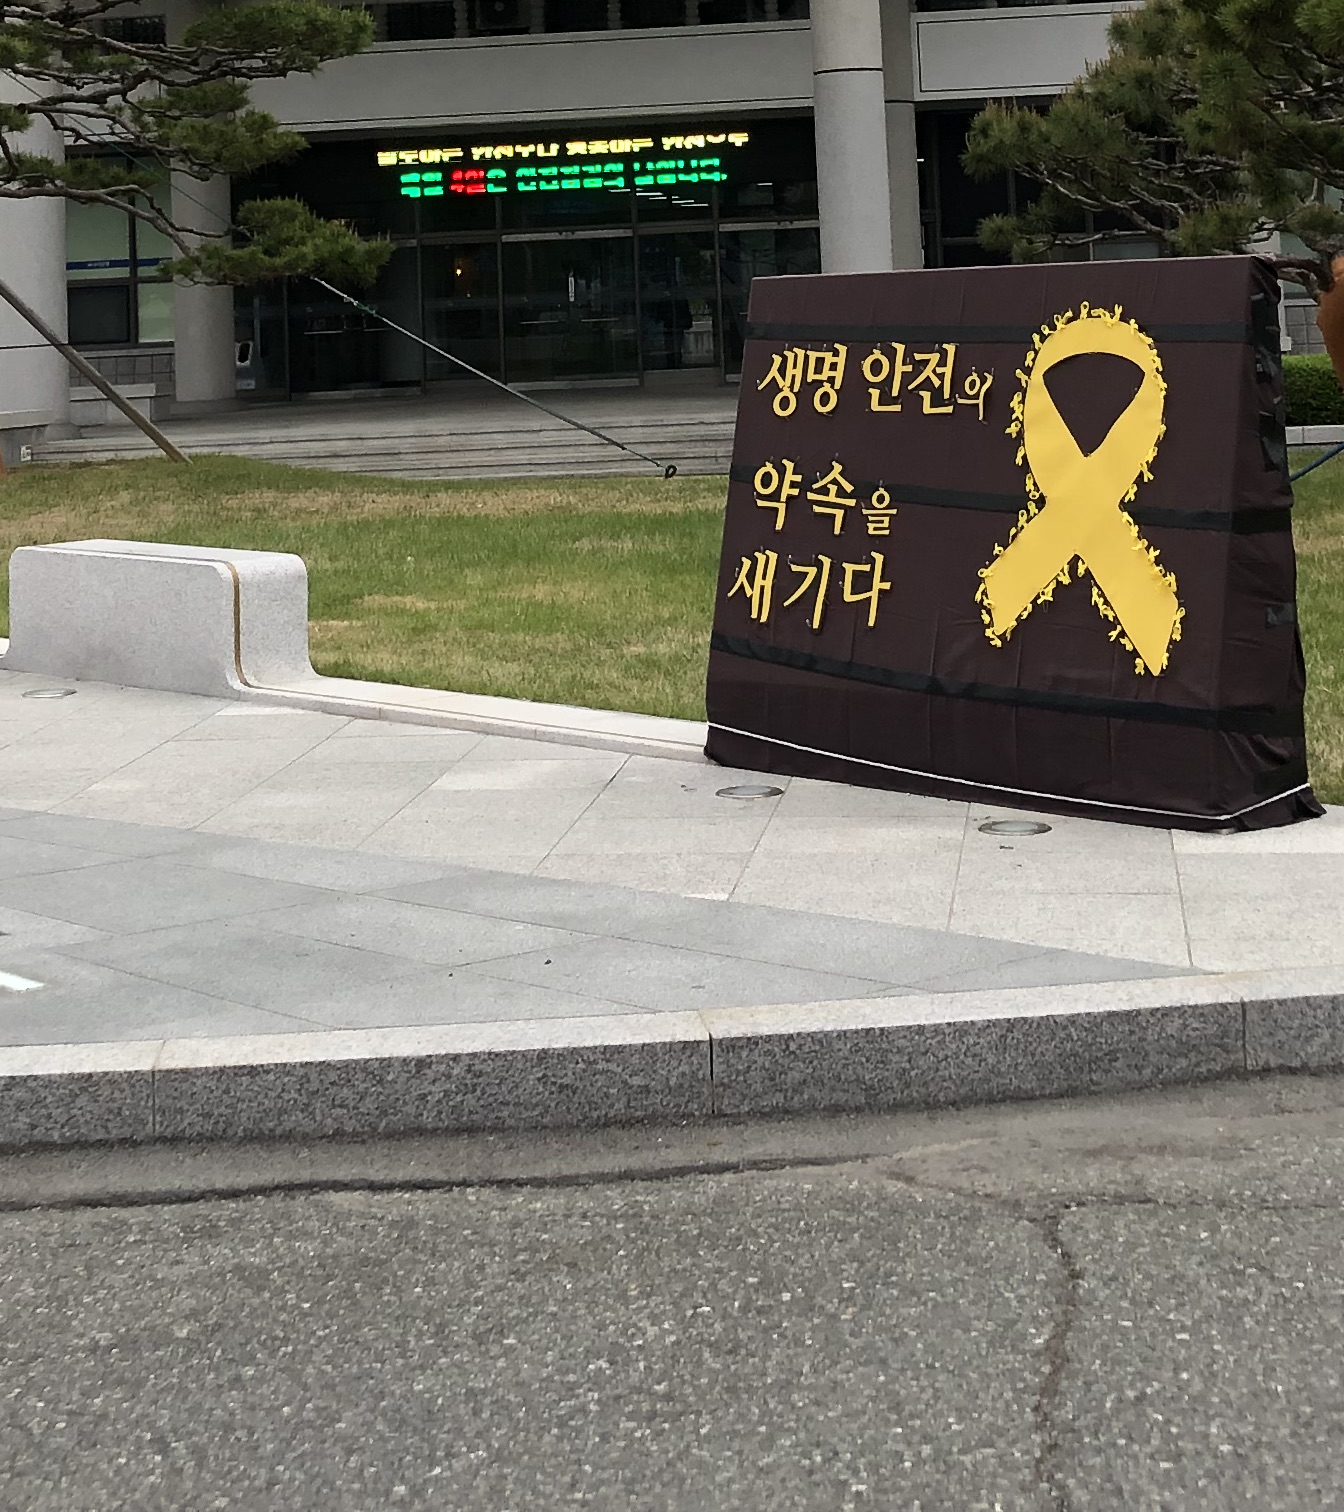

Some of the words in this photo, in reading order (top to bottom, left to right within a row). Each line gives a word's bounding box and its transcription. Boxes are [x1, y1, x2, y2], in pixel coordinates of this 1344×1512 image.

[757, 344, 849, 418] 생명
[862, 342, 994, 421] 안전의
[754, 459, 898, 536] 약속을
[727, 550, 892, 630] 새기다
